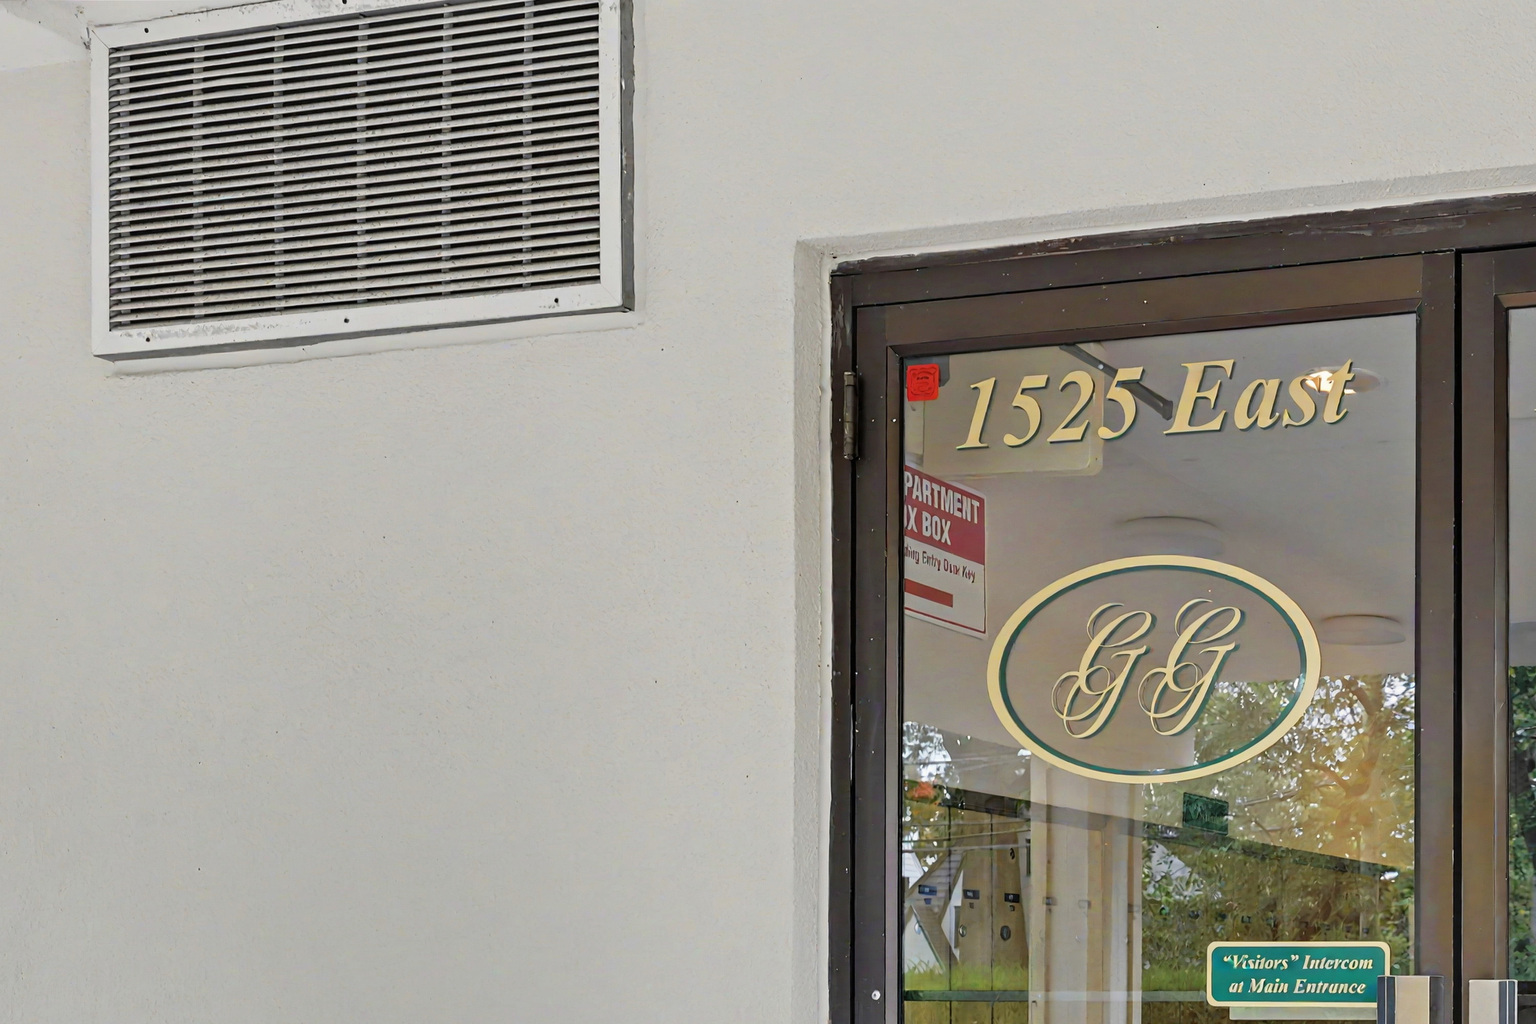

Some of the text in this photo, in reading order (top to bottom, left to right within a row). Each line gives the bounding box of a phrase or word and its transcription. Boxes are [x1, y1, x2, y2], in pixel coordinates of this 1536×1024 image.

[956, 366, 1145, 450] 1525
[1163, 358, 1356, 436] East
[922, 511, 951, 545] BOX
[1302, 954, 1374, 970] Intercom
[1229, 978, 1367, 994] at Main Entrance
